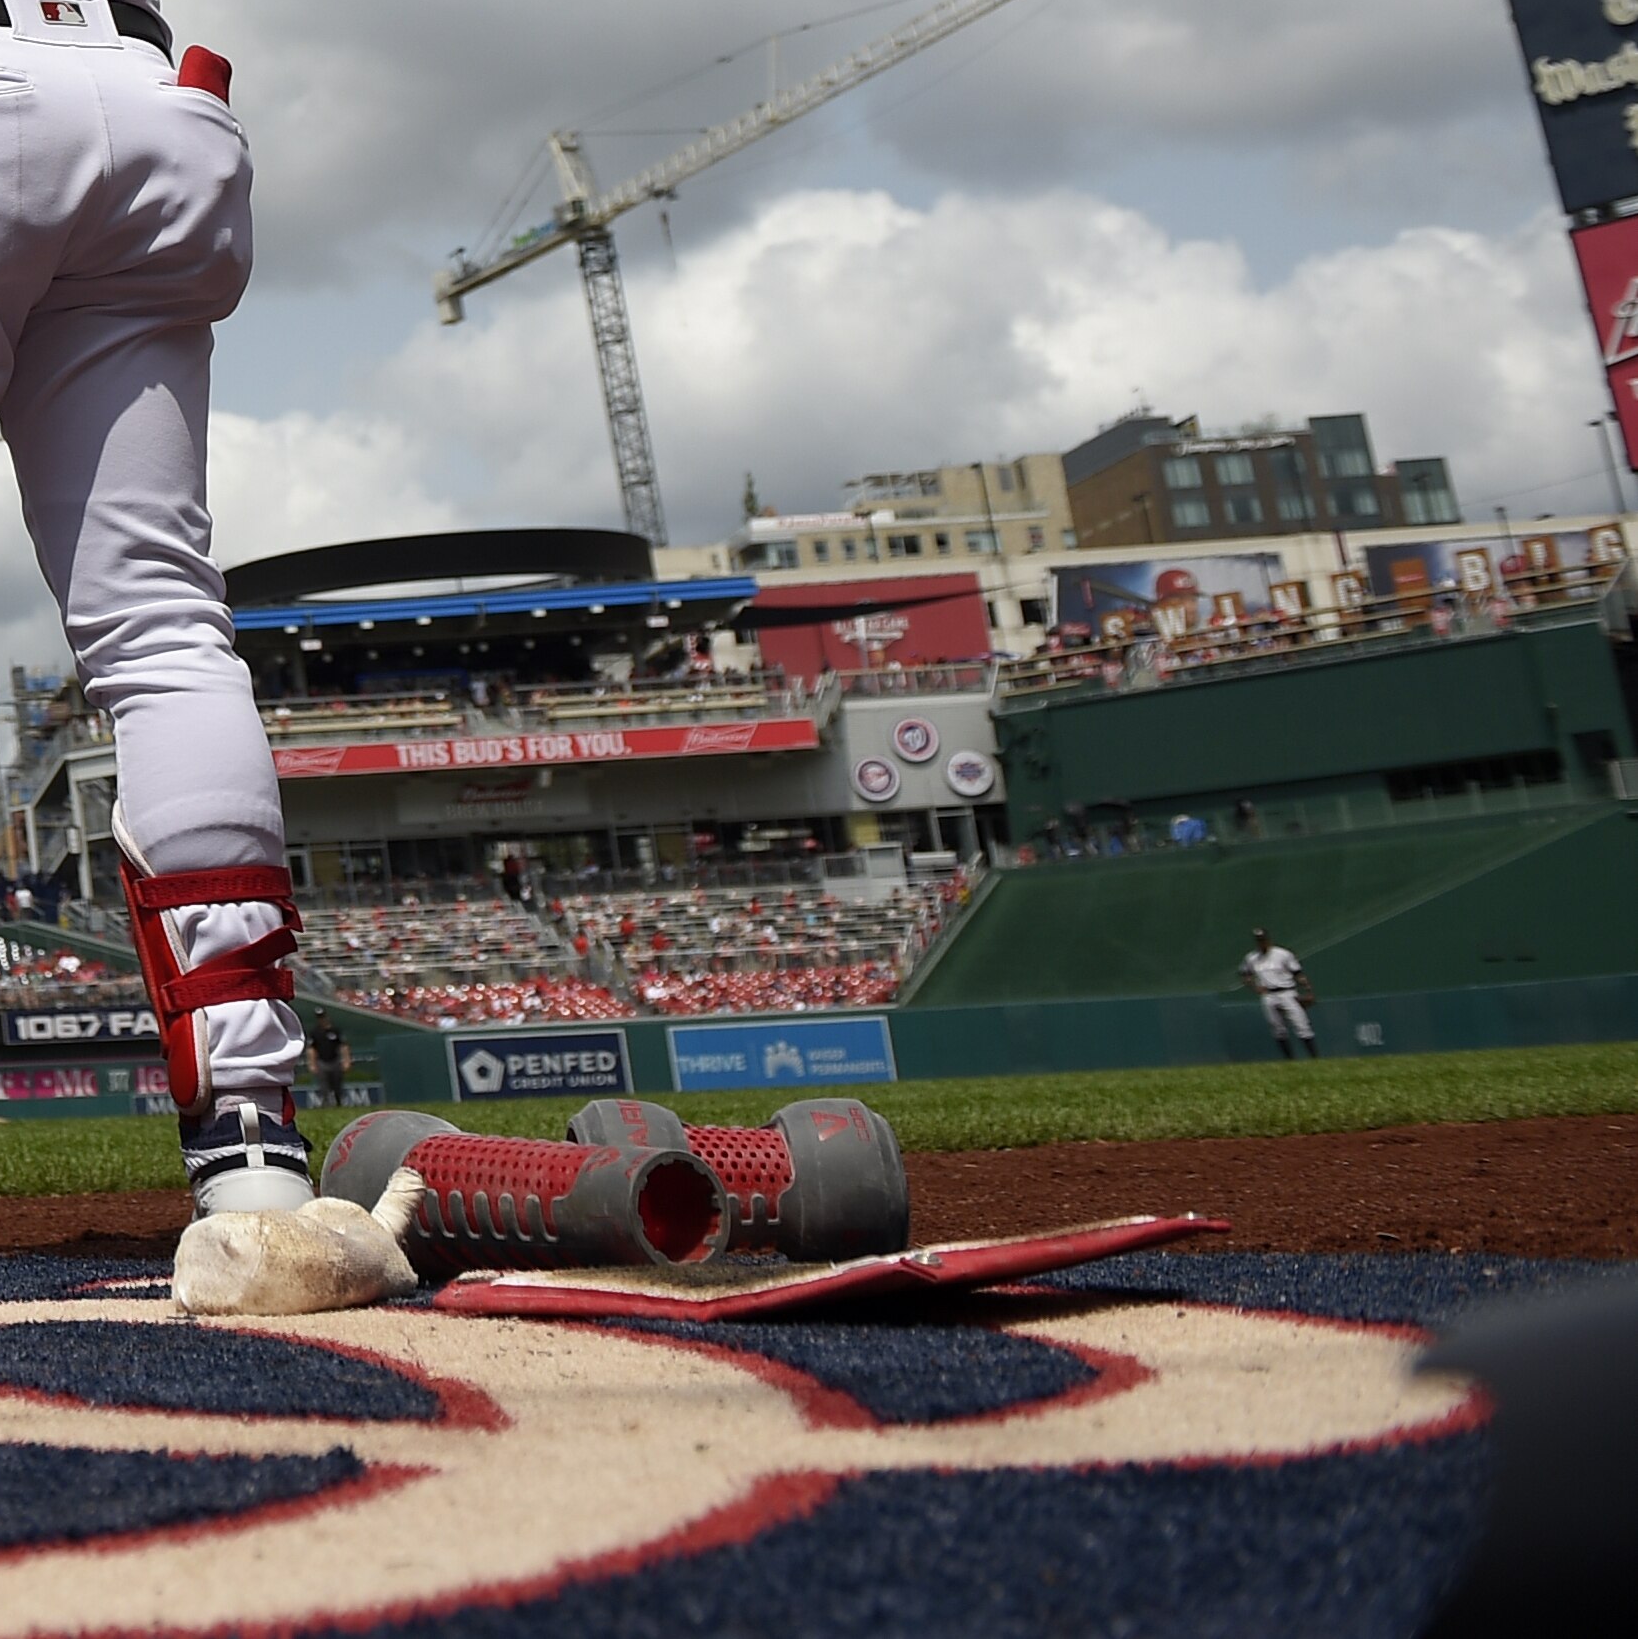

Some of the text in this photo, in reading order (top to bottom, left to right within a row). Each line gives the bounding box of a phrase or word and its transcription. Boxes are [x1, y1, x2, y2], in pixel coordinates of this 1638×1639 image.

[397, 742, 451, 767] THIS
[453, 738, 523, 763] BUD'S
[525, 735, 573, 760] FOR
[574, 730, 633, 757] YOU.
[109, 1011, 160, 1037] FA
[507, 1051, 618, 1077] PENFED
[676, 1054, 747, 1074] THRIVE
[509, 1073, 617, 1090] CREDIT UNION
